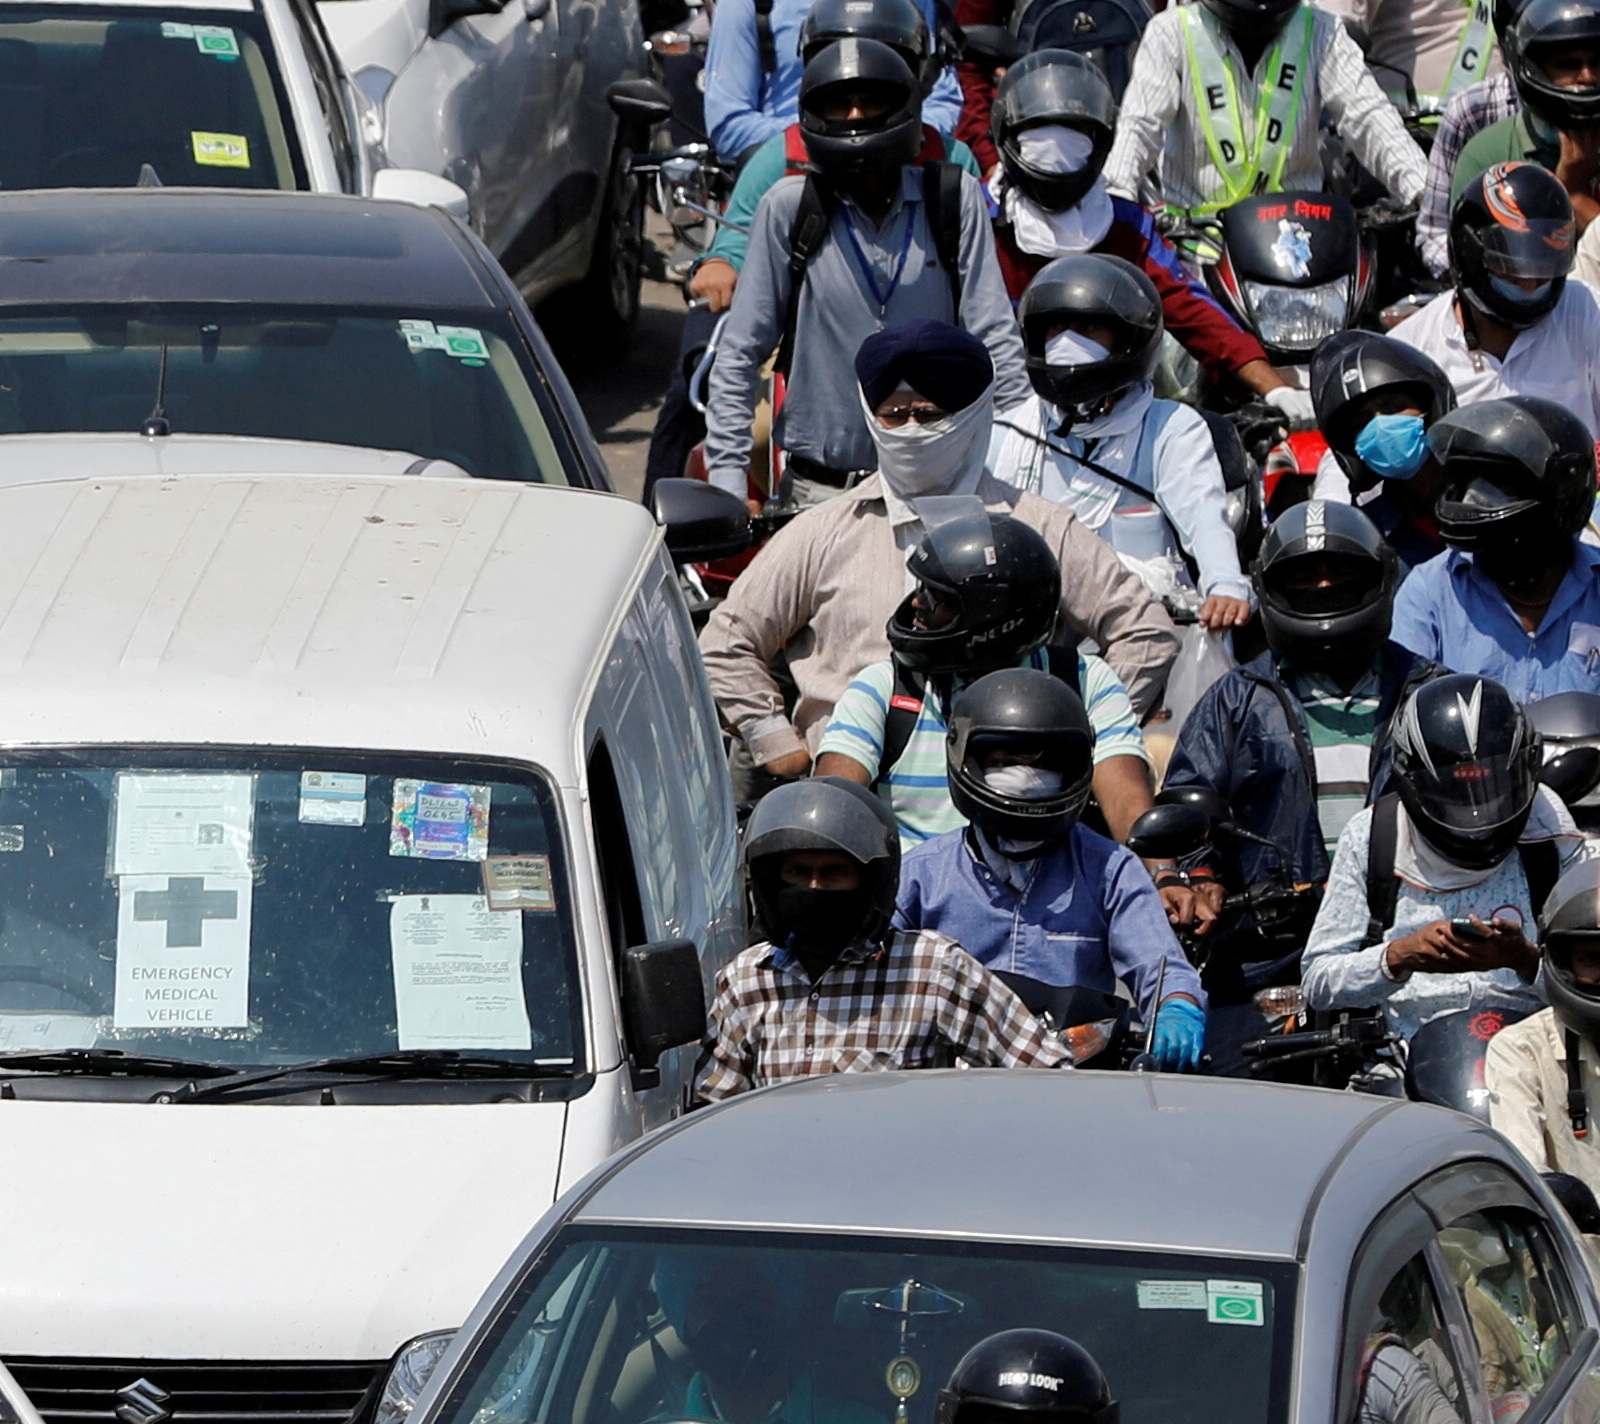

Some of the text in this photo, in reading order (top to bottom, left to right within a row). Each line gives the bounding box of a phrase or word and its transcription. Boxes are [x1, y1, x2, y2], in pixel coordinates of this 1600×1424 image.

[131, 966, 234, 981] EMERGENCY
[144, 987, 218, 1001] MEDICAL
[146, 1008, 214, 1022] VEHICLE
